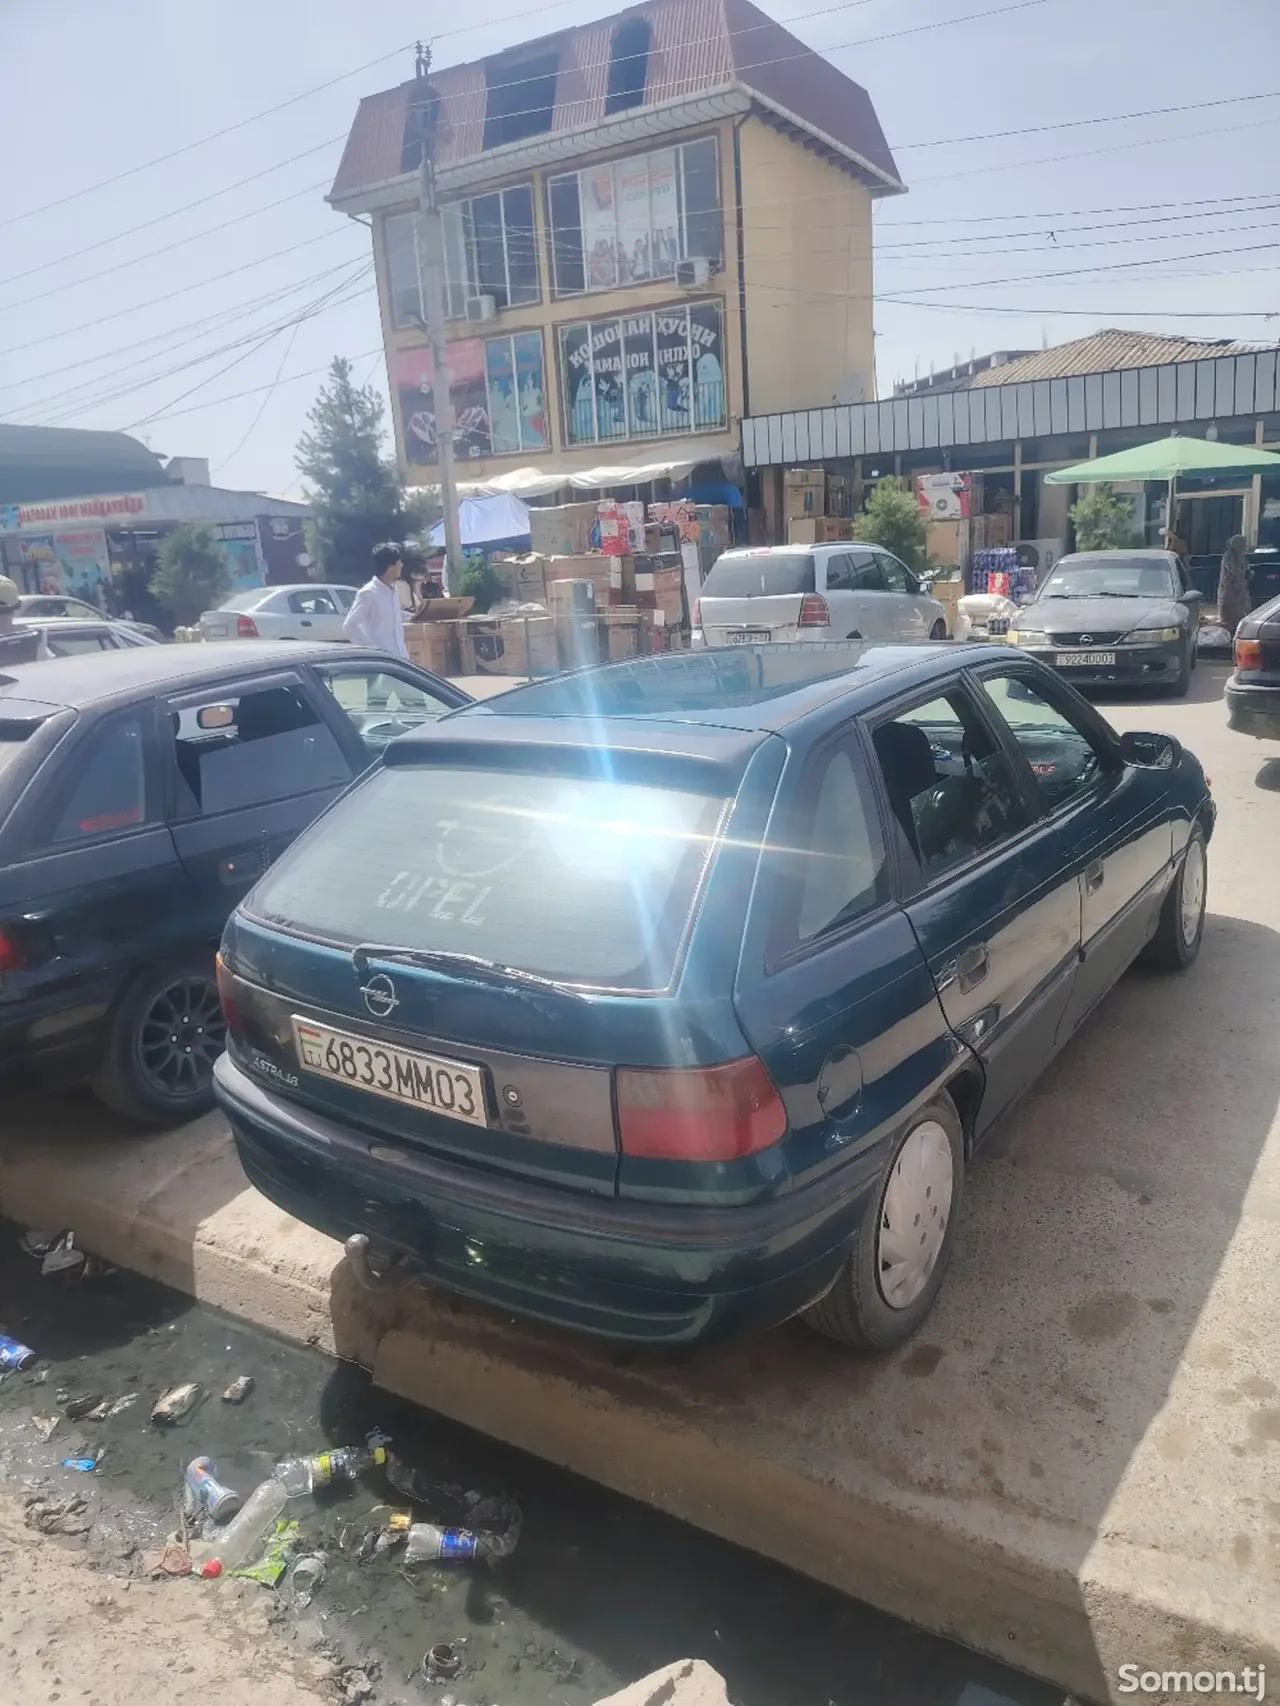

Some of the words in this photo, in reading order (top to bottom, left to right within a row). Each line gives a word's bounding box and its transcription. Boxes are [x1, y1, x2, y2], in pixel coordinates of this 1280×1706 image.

[376, 870, 494, 926] OPEL
[253, 1057, 284, 1081] ASTRA
[325, 1037, 476, 1117] 6833MM03
